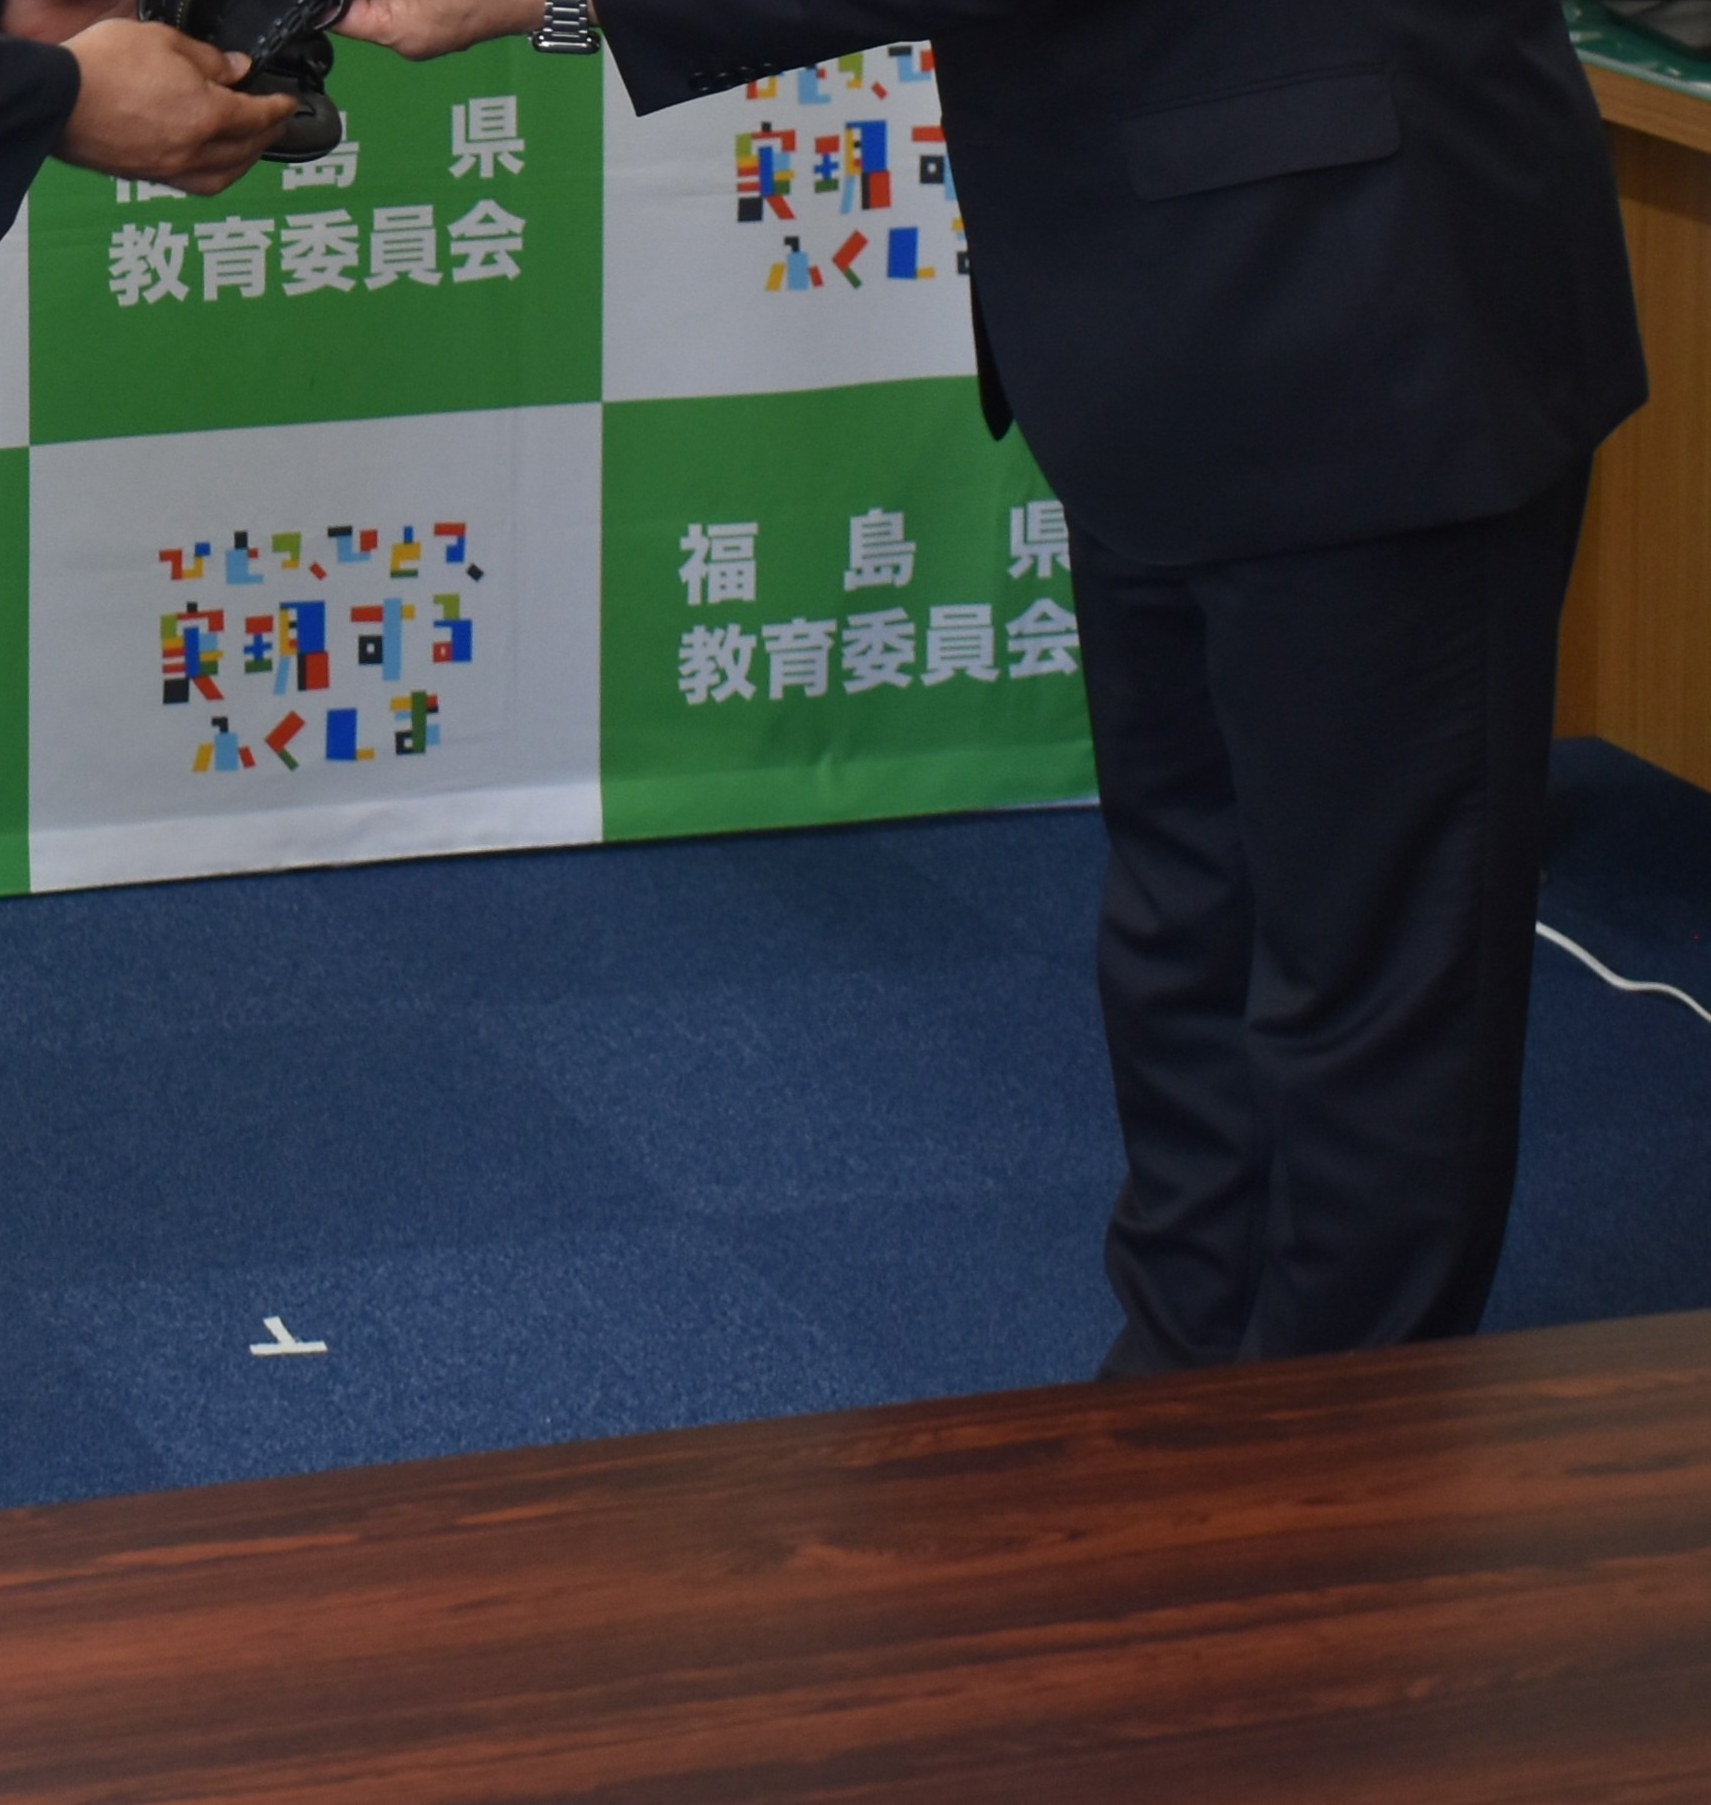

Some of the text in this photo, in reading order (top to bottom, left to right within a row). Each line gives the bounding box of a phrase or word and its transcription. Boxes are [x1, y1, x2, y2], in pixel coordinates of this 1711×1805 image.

[109, 199, 526, 306] 教育委員会
[680, 500, 1070, 605] 福島県
[679, 599, 1079, 705] 教育委員会
